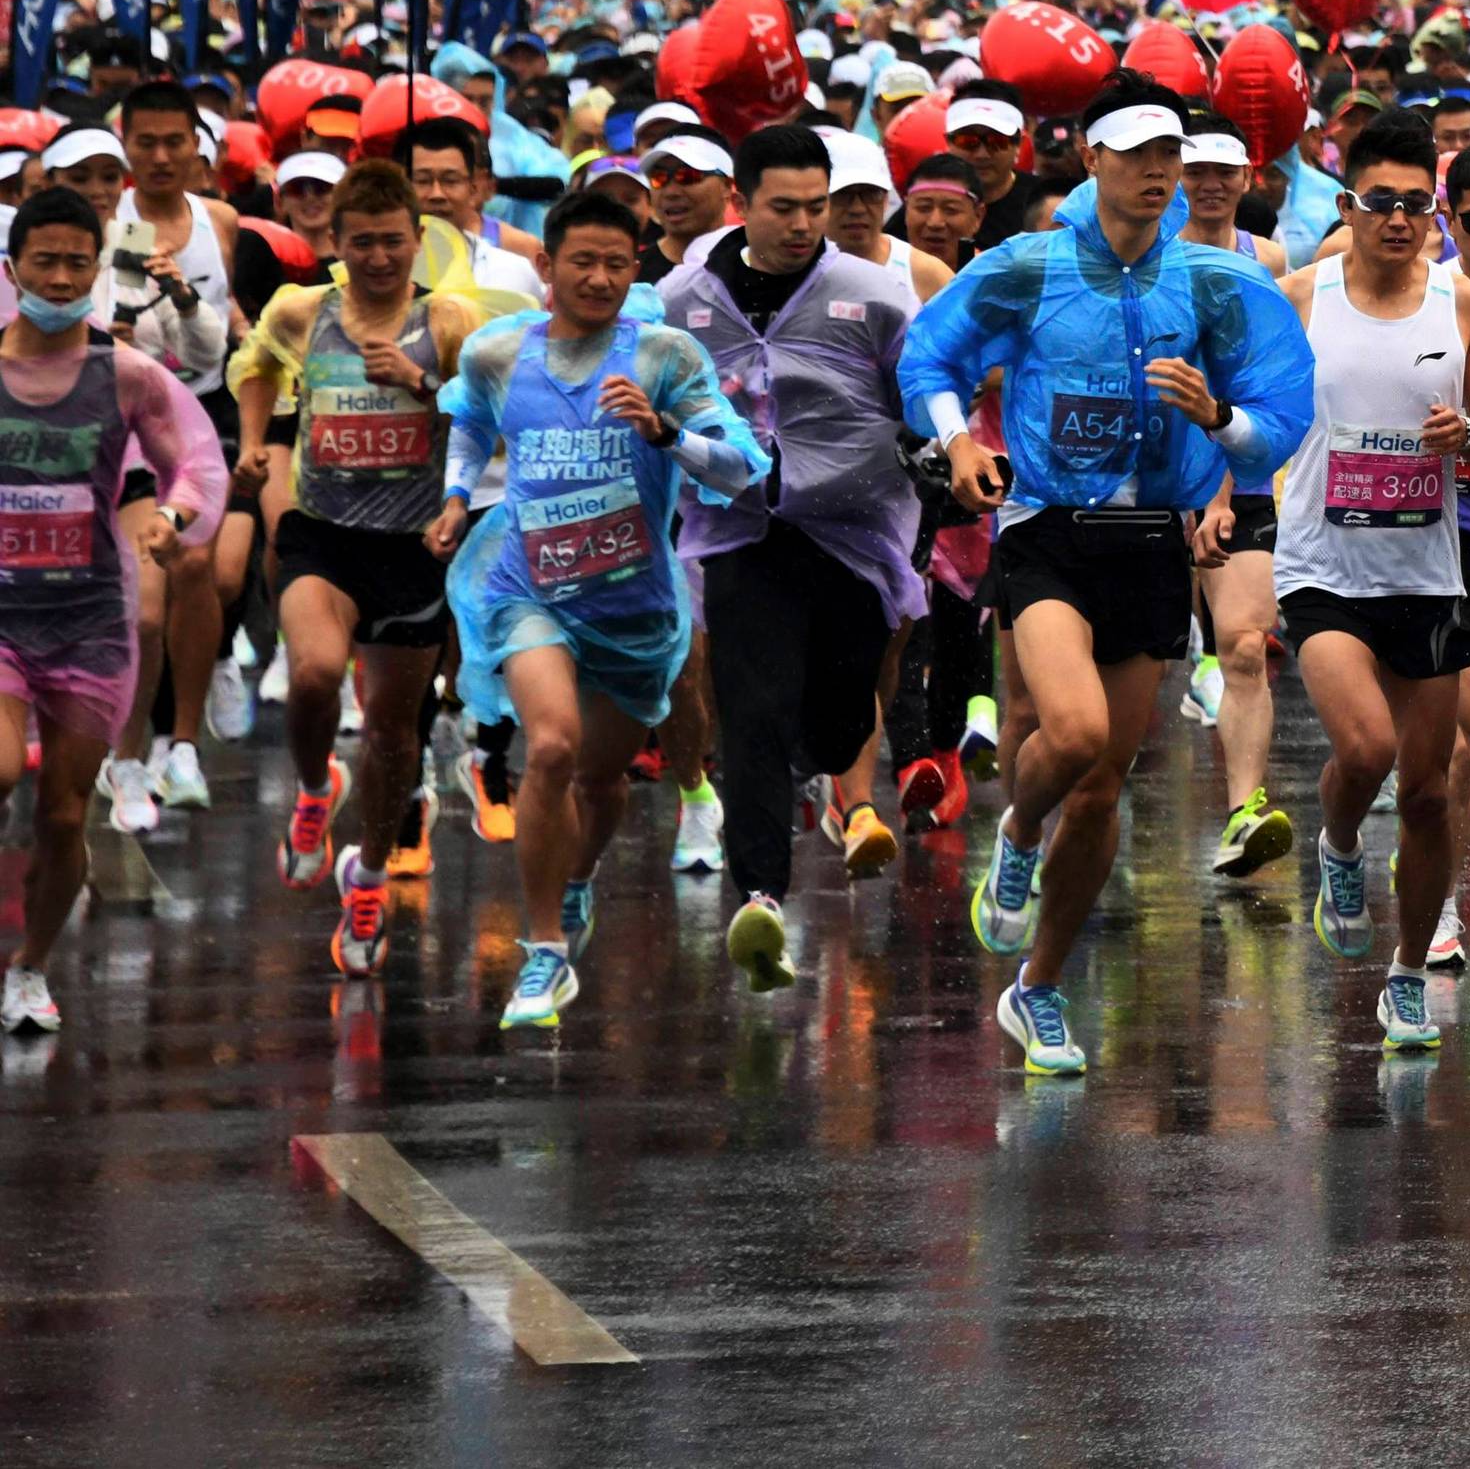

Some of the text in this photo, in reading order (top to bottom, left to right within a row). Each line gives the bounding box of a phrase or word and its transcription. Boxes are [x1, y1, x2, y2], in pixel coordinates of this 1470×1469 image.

[747, 12, 797, 103] 4:15
[337, 394, 396, 411] Haier
[319, 427, 418, 455] A5137
[518, 427, 632, 462] 奔跑海尔
[1361, 432, 1423, 452] Haier
[1333, 486, 1373, 501] 配速员
[1382, 474, 1439, 498] 3:00
[1, 492, 65, 510] Haier
[544, 496, 607, 523] Haier
[538, 522, 637, 570] A5432
